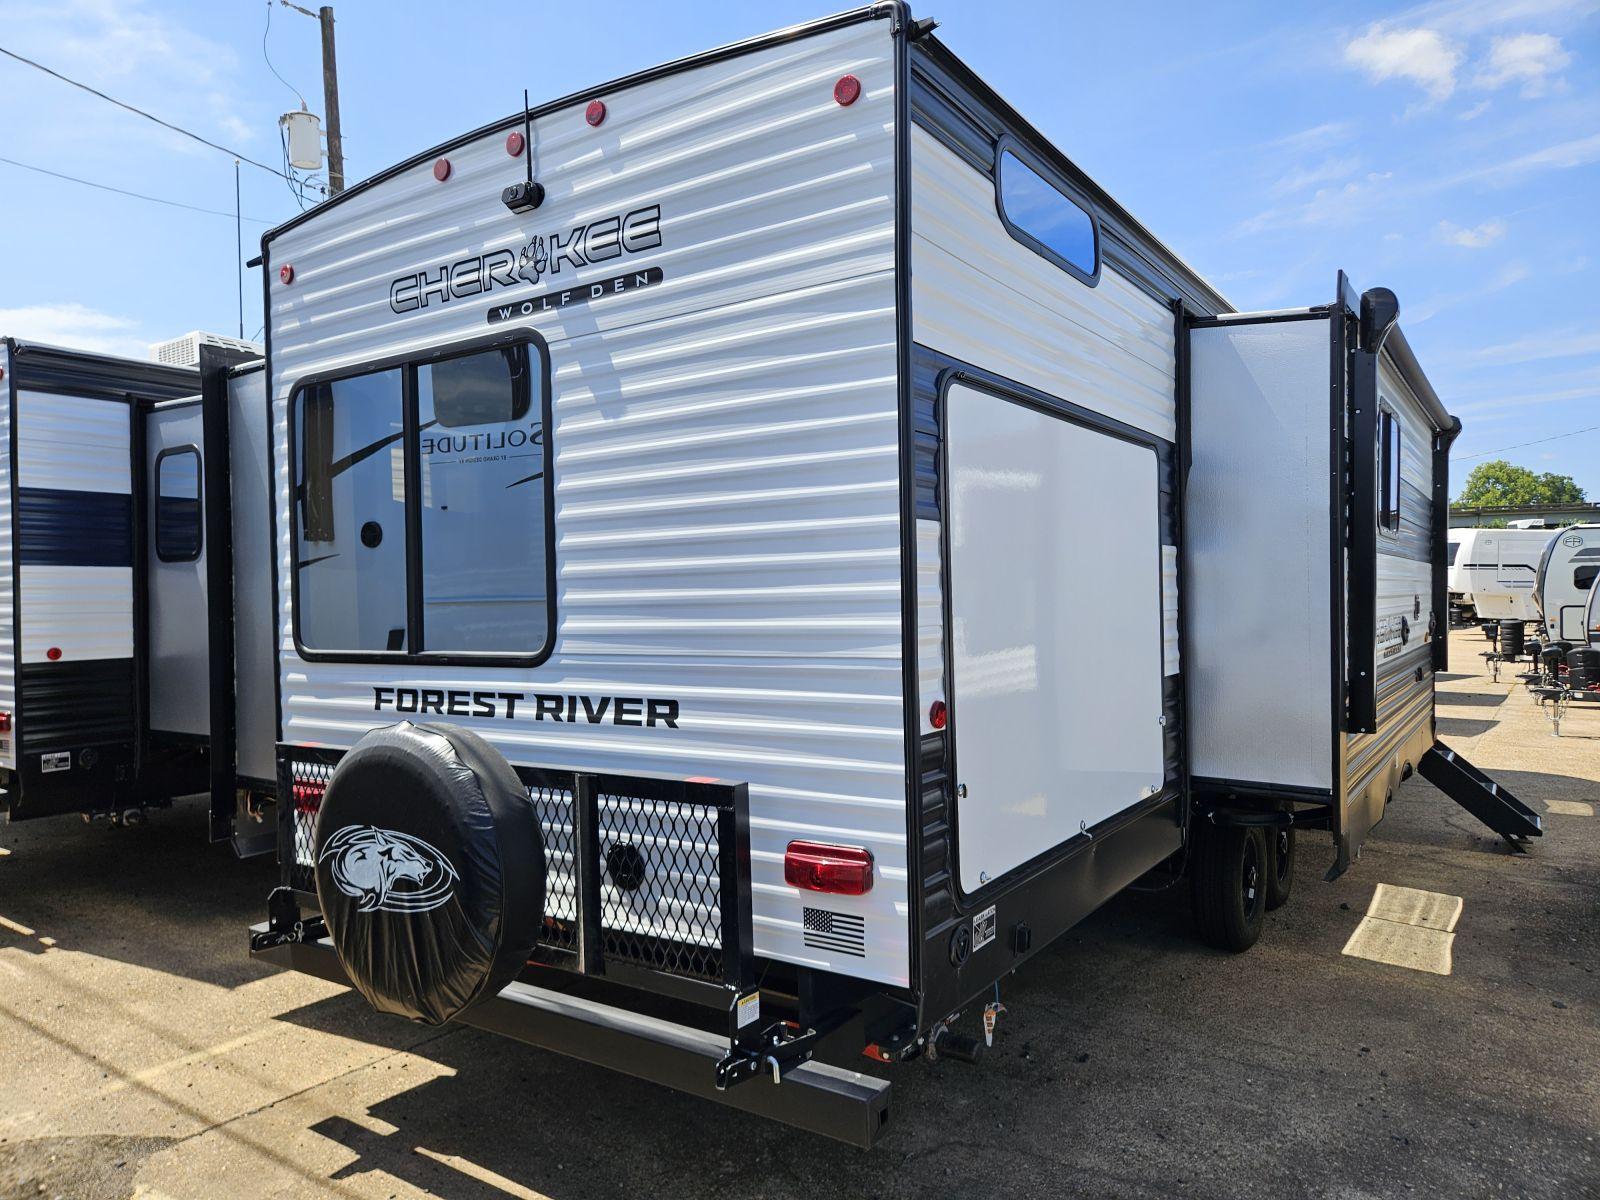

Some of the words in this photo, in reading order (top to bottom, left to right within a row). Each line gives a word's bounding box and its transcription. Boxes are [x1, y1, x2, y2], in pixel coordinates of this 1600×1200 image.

[498, 292, 572, 320] WOLF
[591, 272, 649, 299] DEN
[373, 687, 524, 719] FOREST
[533, 694, 679, 729] RIVER
